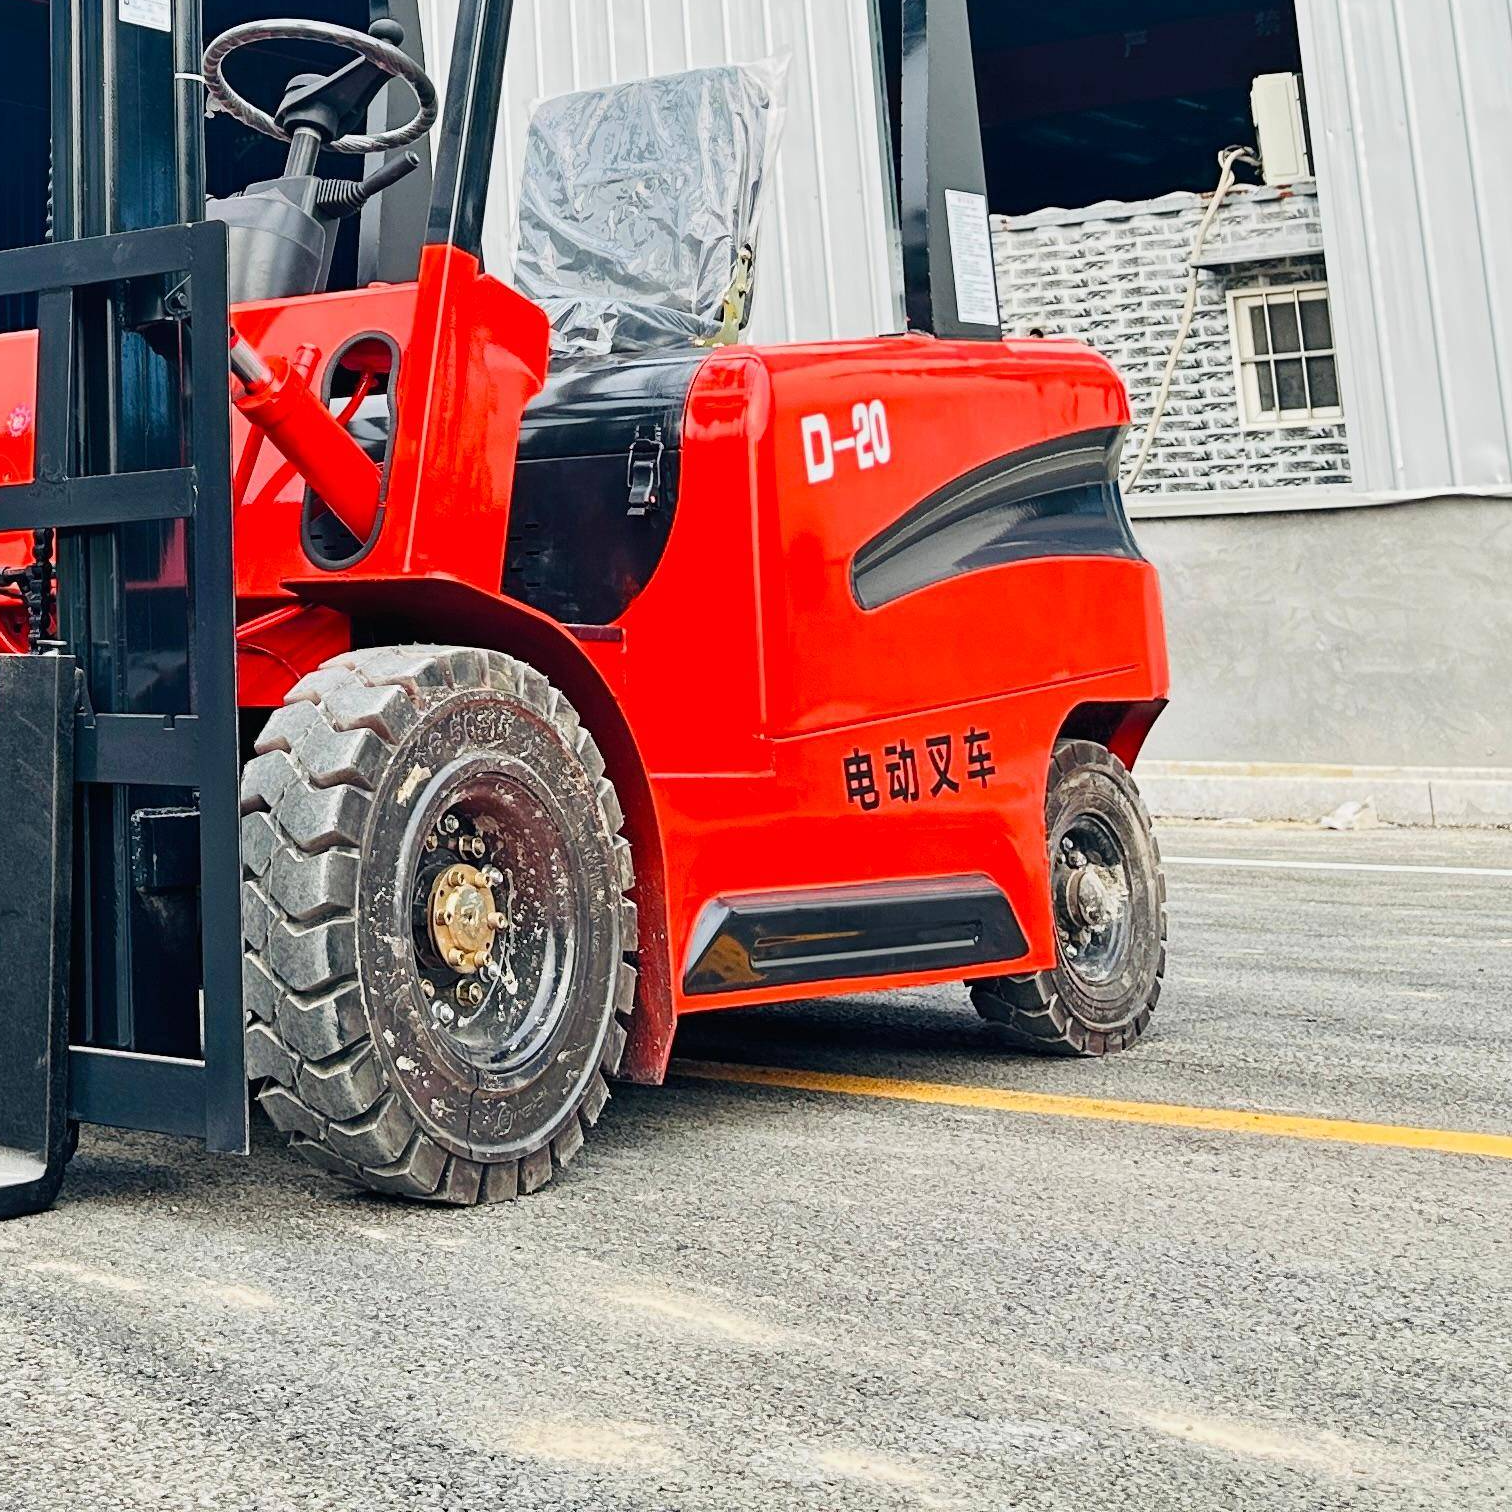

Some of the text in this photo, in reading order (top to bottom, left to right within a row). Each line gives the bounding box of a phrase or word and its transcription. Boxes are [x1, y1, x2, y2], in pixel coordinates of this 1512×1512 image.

[801, 399, 891, 484] D-20
[843, 726, 997, 811] 电动叉车
